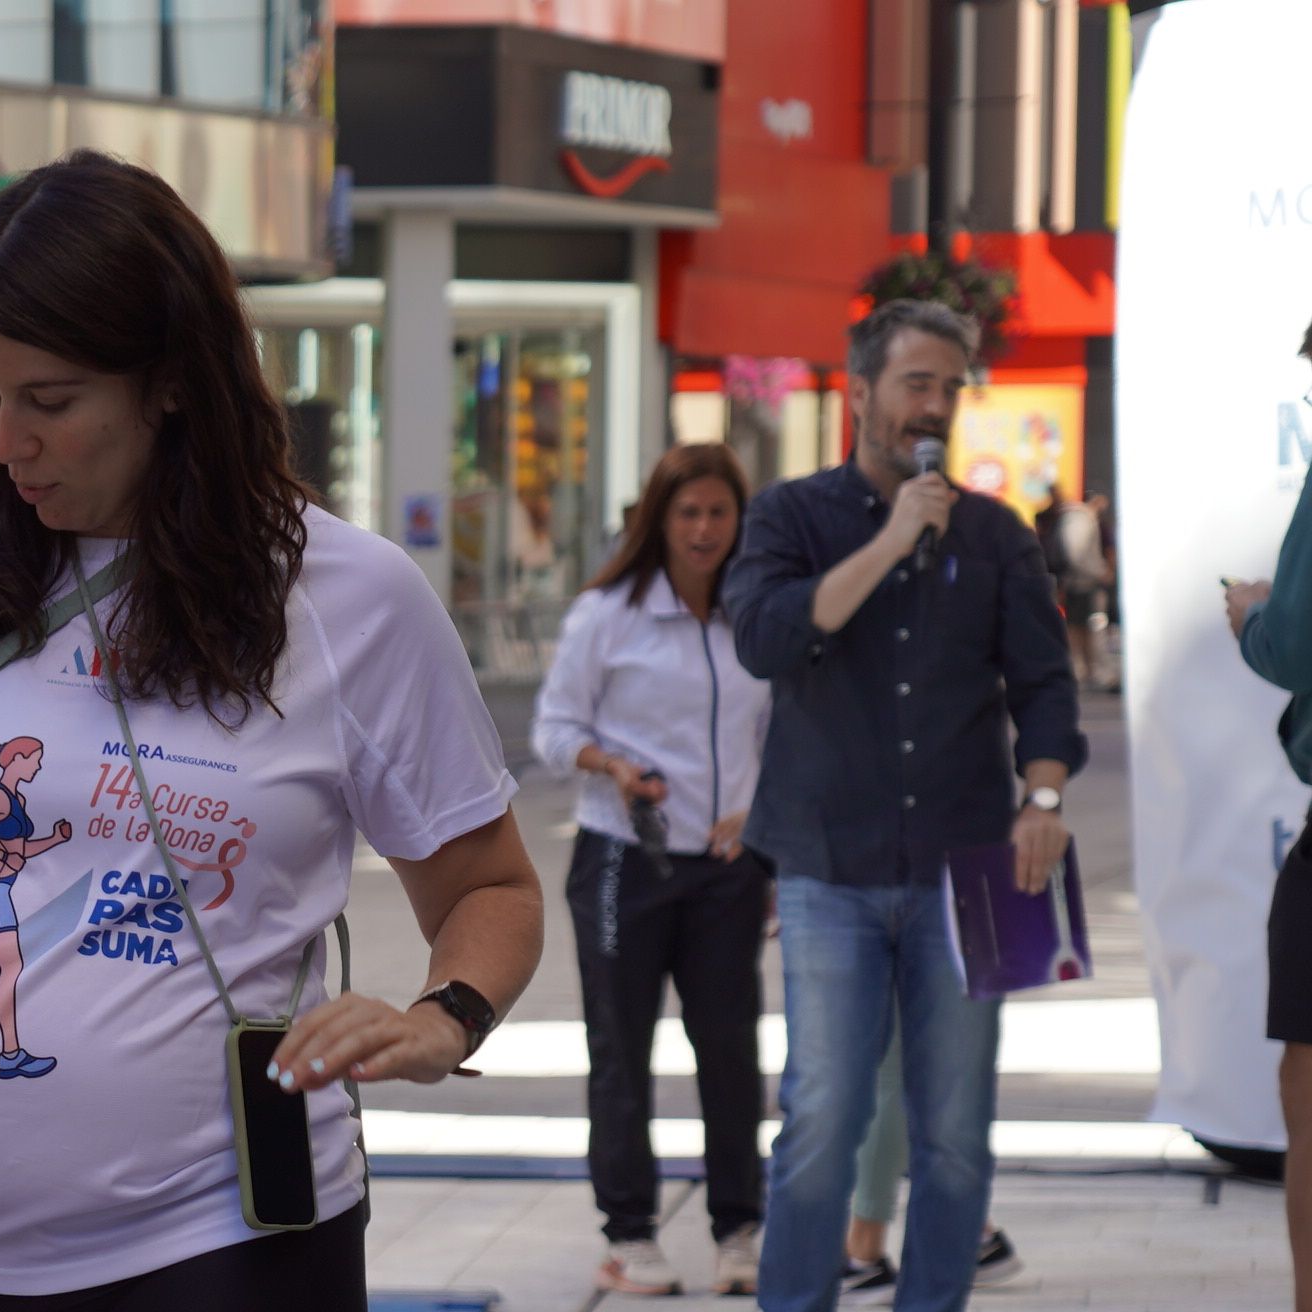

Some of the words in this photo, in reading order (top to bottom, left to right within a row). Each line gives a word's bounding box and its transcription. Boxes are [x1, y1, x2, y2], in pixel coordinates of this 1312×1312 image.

[562, 69, 673, 158] PRIMOR
[165, 753, 237, 773] ASSEGURANCES
[152, 784, 229, 822] Cursa
[88, 813, 116, 839] de
[126, 816, 150, 842] la
[88, 899, 184, 933] PAS
[77, 930, 178, 966] SUMA
